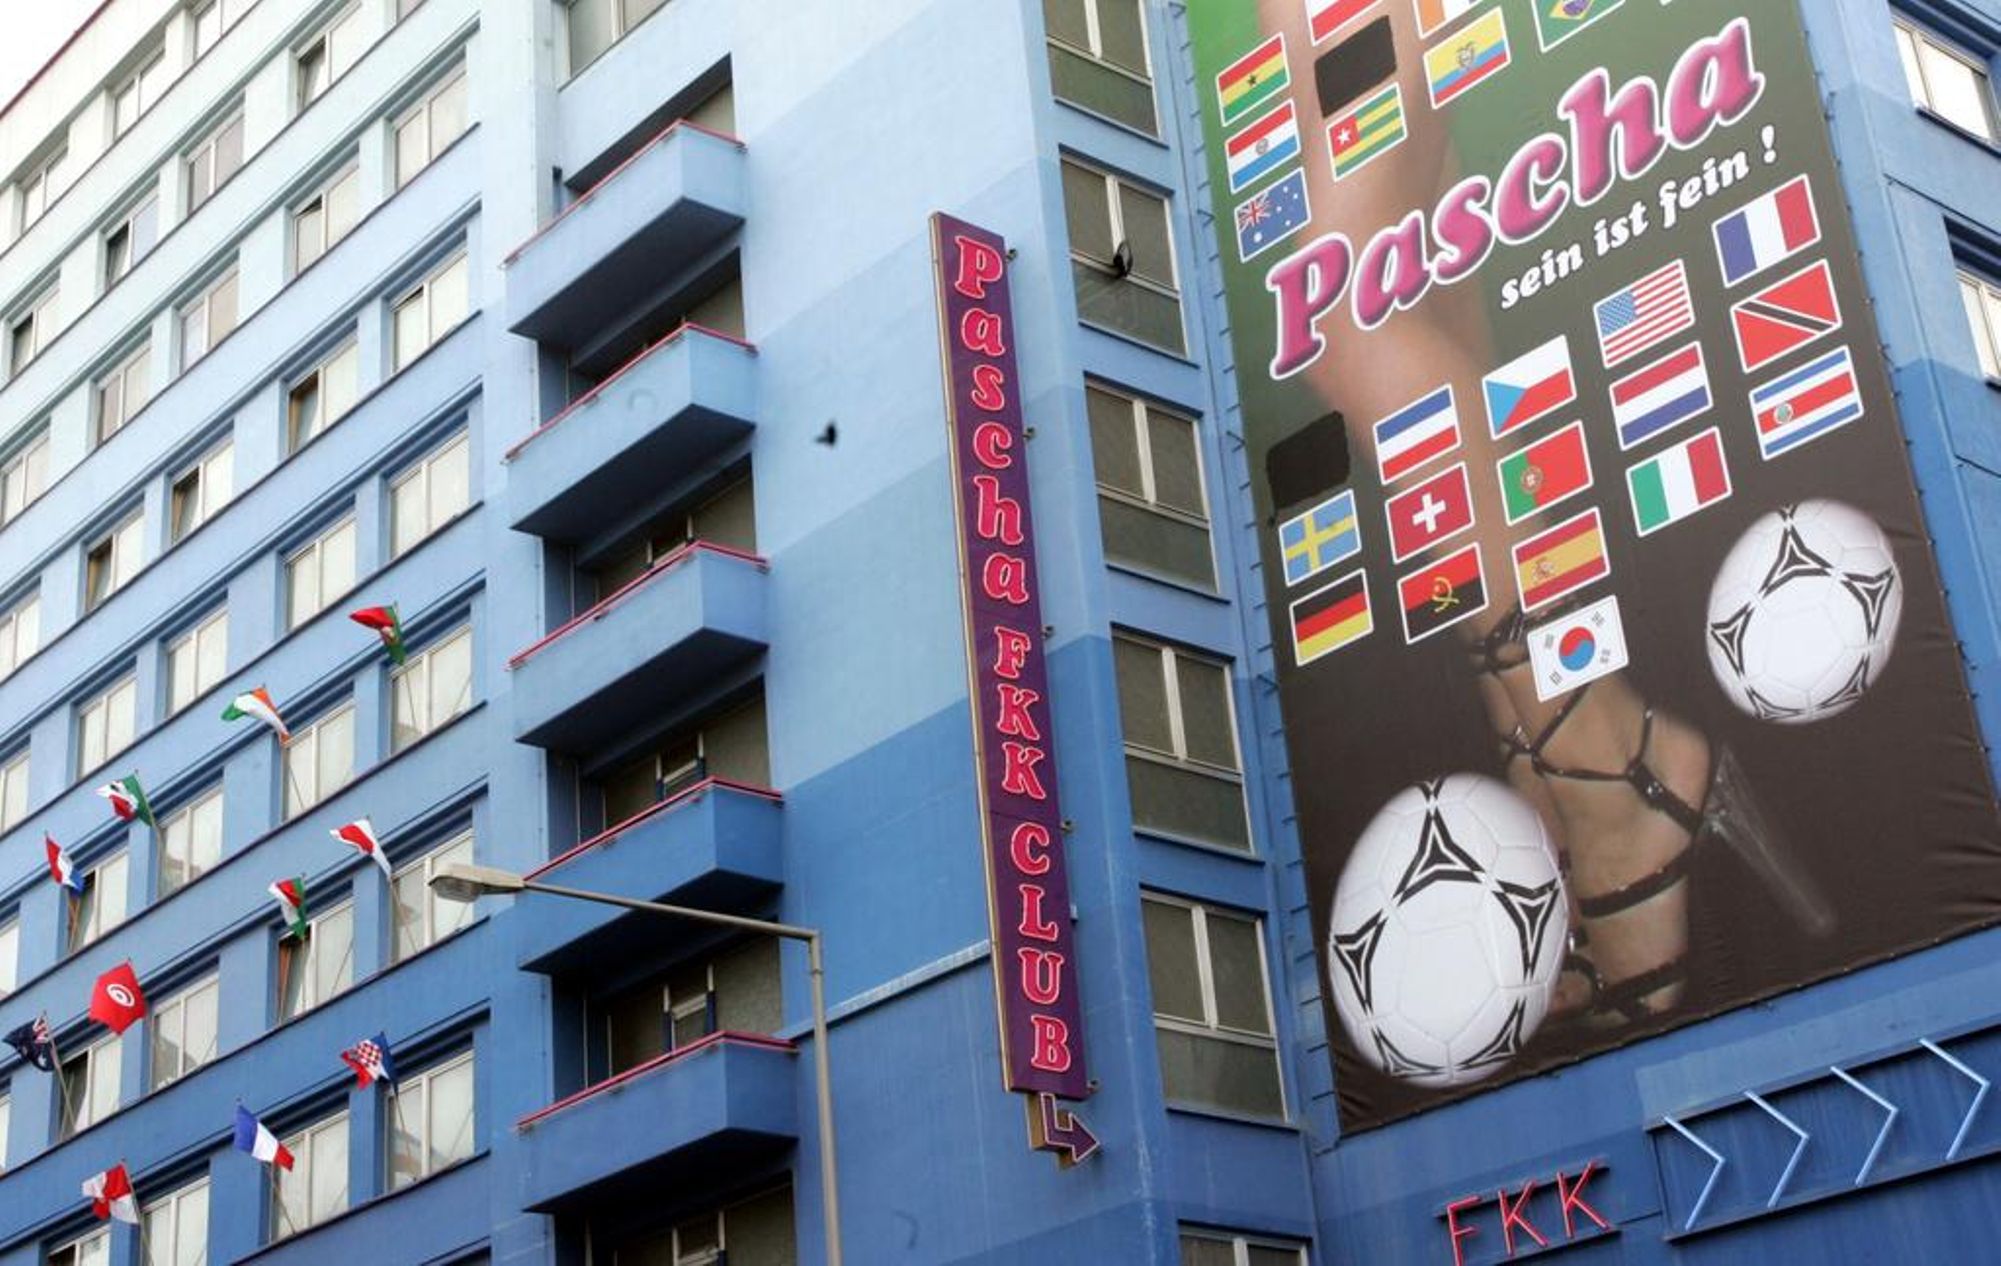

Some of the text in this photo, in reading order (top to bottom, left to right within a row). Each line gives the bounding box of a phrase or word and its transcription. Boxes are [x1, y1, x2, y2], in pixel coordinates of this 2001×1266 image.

[1267, 17, 1765, 380] Pascha
[1501, 243, 1583, 309] sein
[1593, 201, 1648, 256] ist
[1659, 151, 1749, 228] fein
[955, 235, 1071, 1072] Pascha FKK CLUB
[1447, 1159, 1611, 1266] FKK
